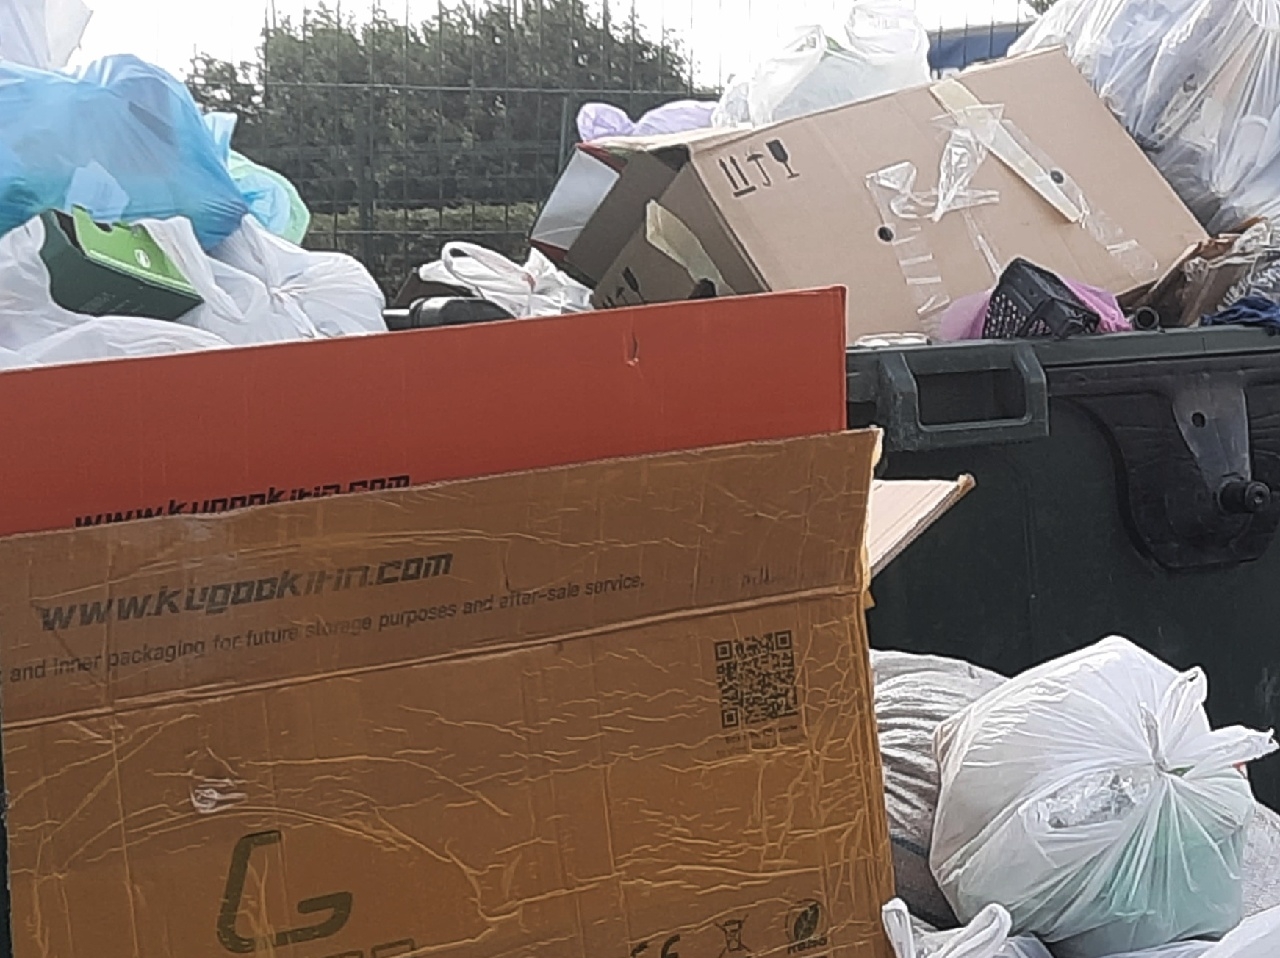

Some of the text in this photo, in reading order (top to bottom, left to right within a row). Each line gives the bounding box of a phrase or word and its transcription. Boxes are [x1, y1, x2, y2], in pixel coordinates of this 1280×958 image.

[41, 553, 453, 631] www.kugookirin.com
[9, 658, 47, 683] and
[107, 636, 206, 671] packaging
[245, 625, 299, 648] future
[378, 604, 457, 632] purposes
[462, 594, 494, 615] and
